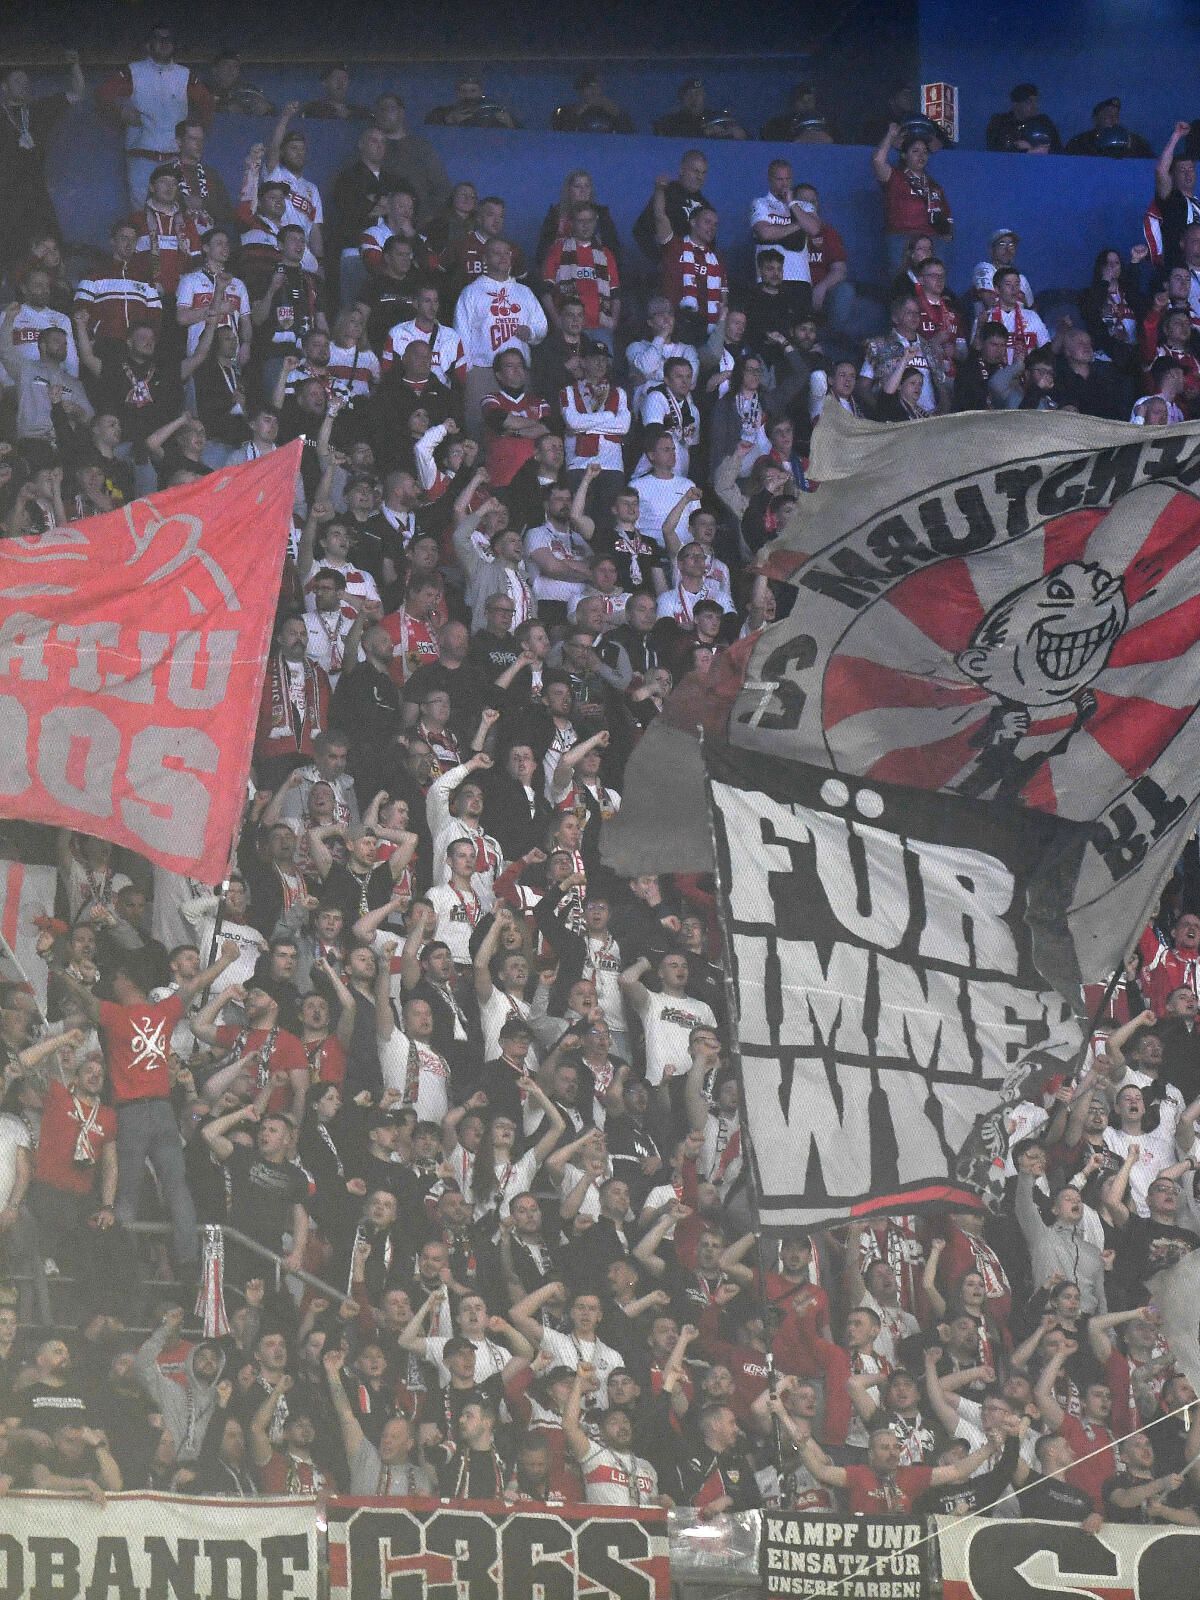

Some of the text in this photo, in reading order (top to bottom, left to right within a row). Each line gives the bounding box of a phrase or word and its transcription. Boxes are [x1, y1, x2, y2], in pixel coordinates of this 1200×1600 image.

[710, 778, 1020, 977] FÜR
[767, 1518, 921, 1549] KAMPF UND
[767, 1547, 921, 1577] EINSATZ FÜR
[768, 1575, 921, 1599] UNSERE FARBEN!
